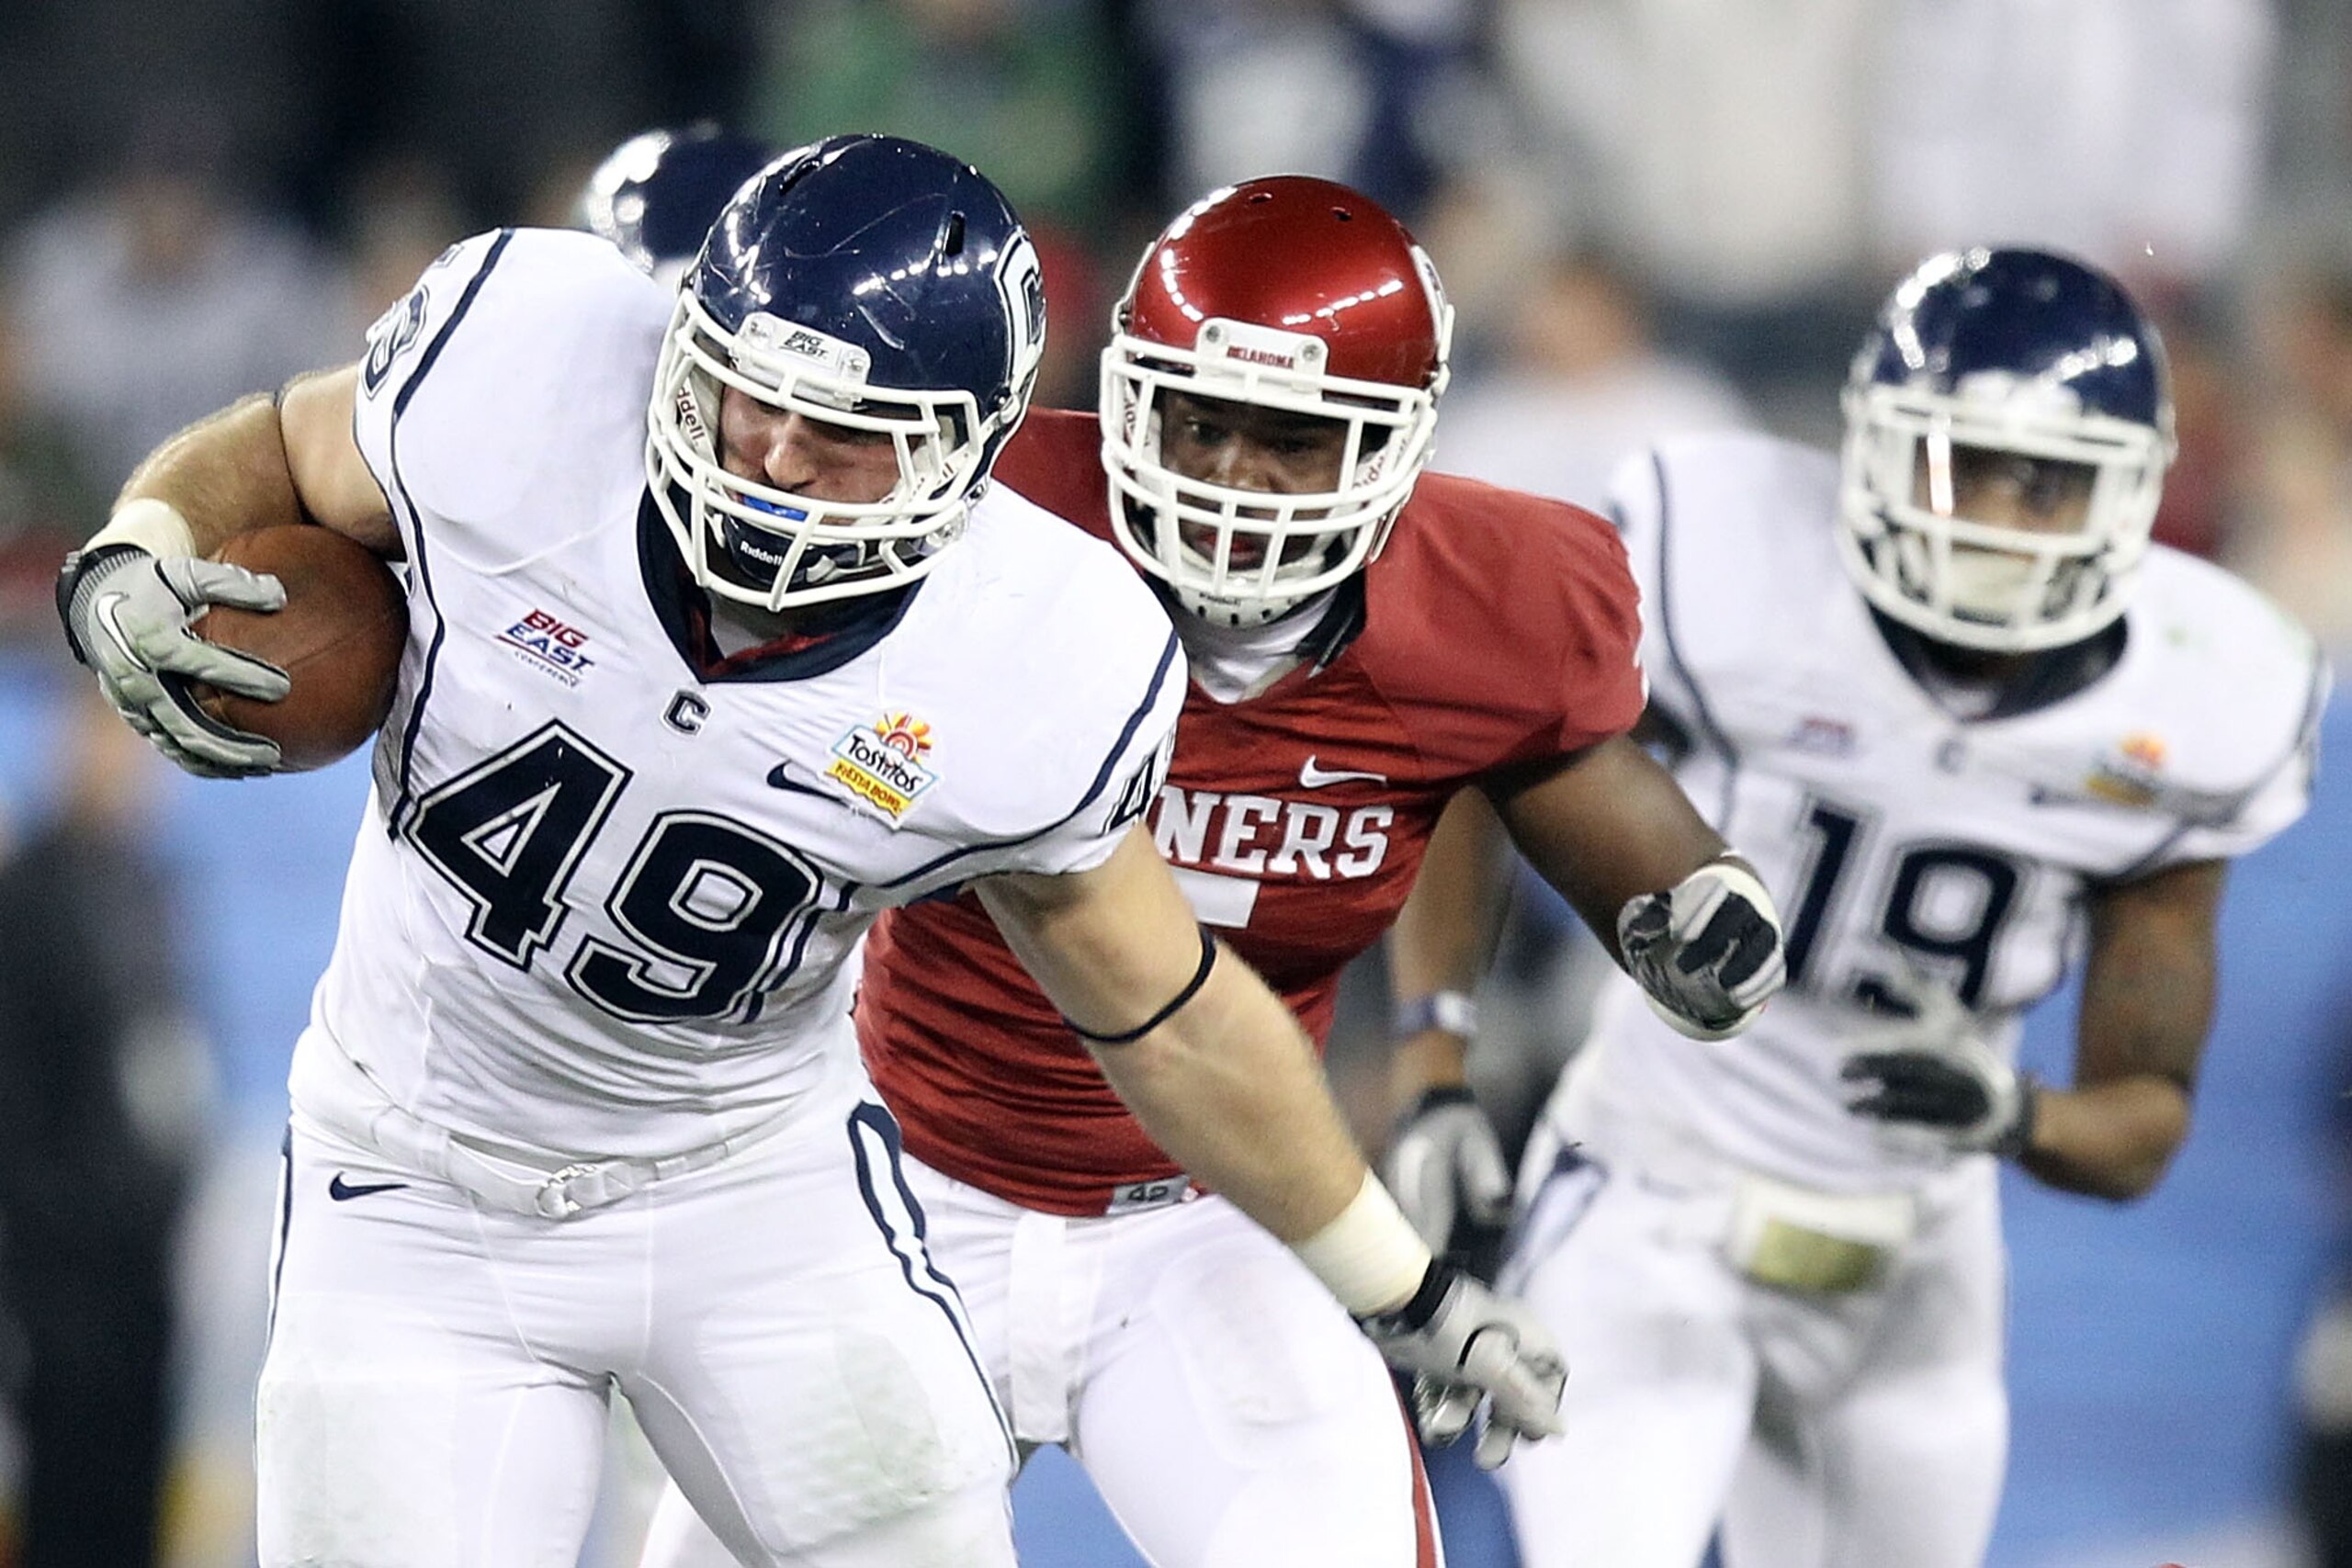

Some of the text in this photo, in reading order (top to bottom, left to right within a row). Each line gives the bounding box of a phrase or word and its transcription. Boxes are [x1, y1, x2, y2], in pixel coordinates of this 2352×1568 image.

[784, 337, 828, 358] EAST
[791, 330, 824, 347] BIG
[740, 539, 783, 567] Riddell
[505, 622, 595, 671] EAST
[523, 608, 590, 649] BIG
[663, 691, 711, 736] C
[848, 733, 923, 793] Tostitos
[1154, 784, 1394, 879] NERS
[402, 717, 824, 1025] 49
[1786, 792, 2026, 1015] 19
